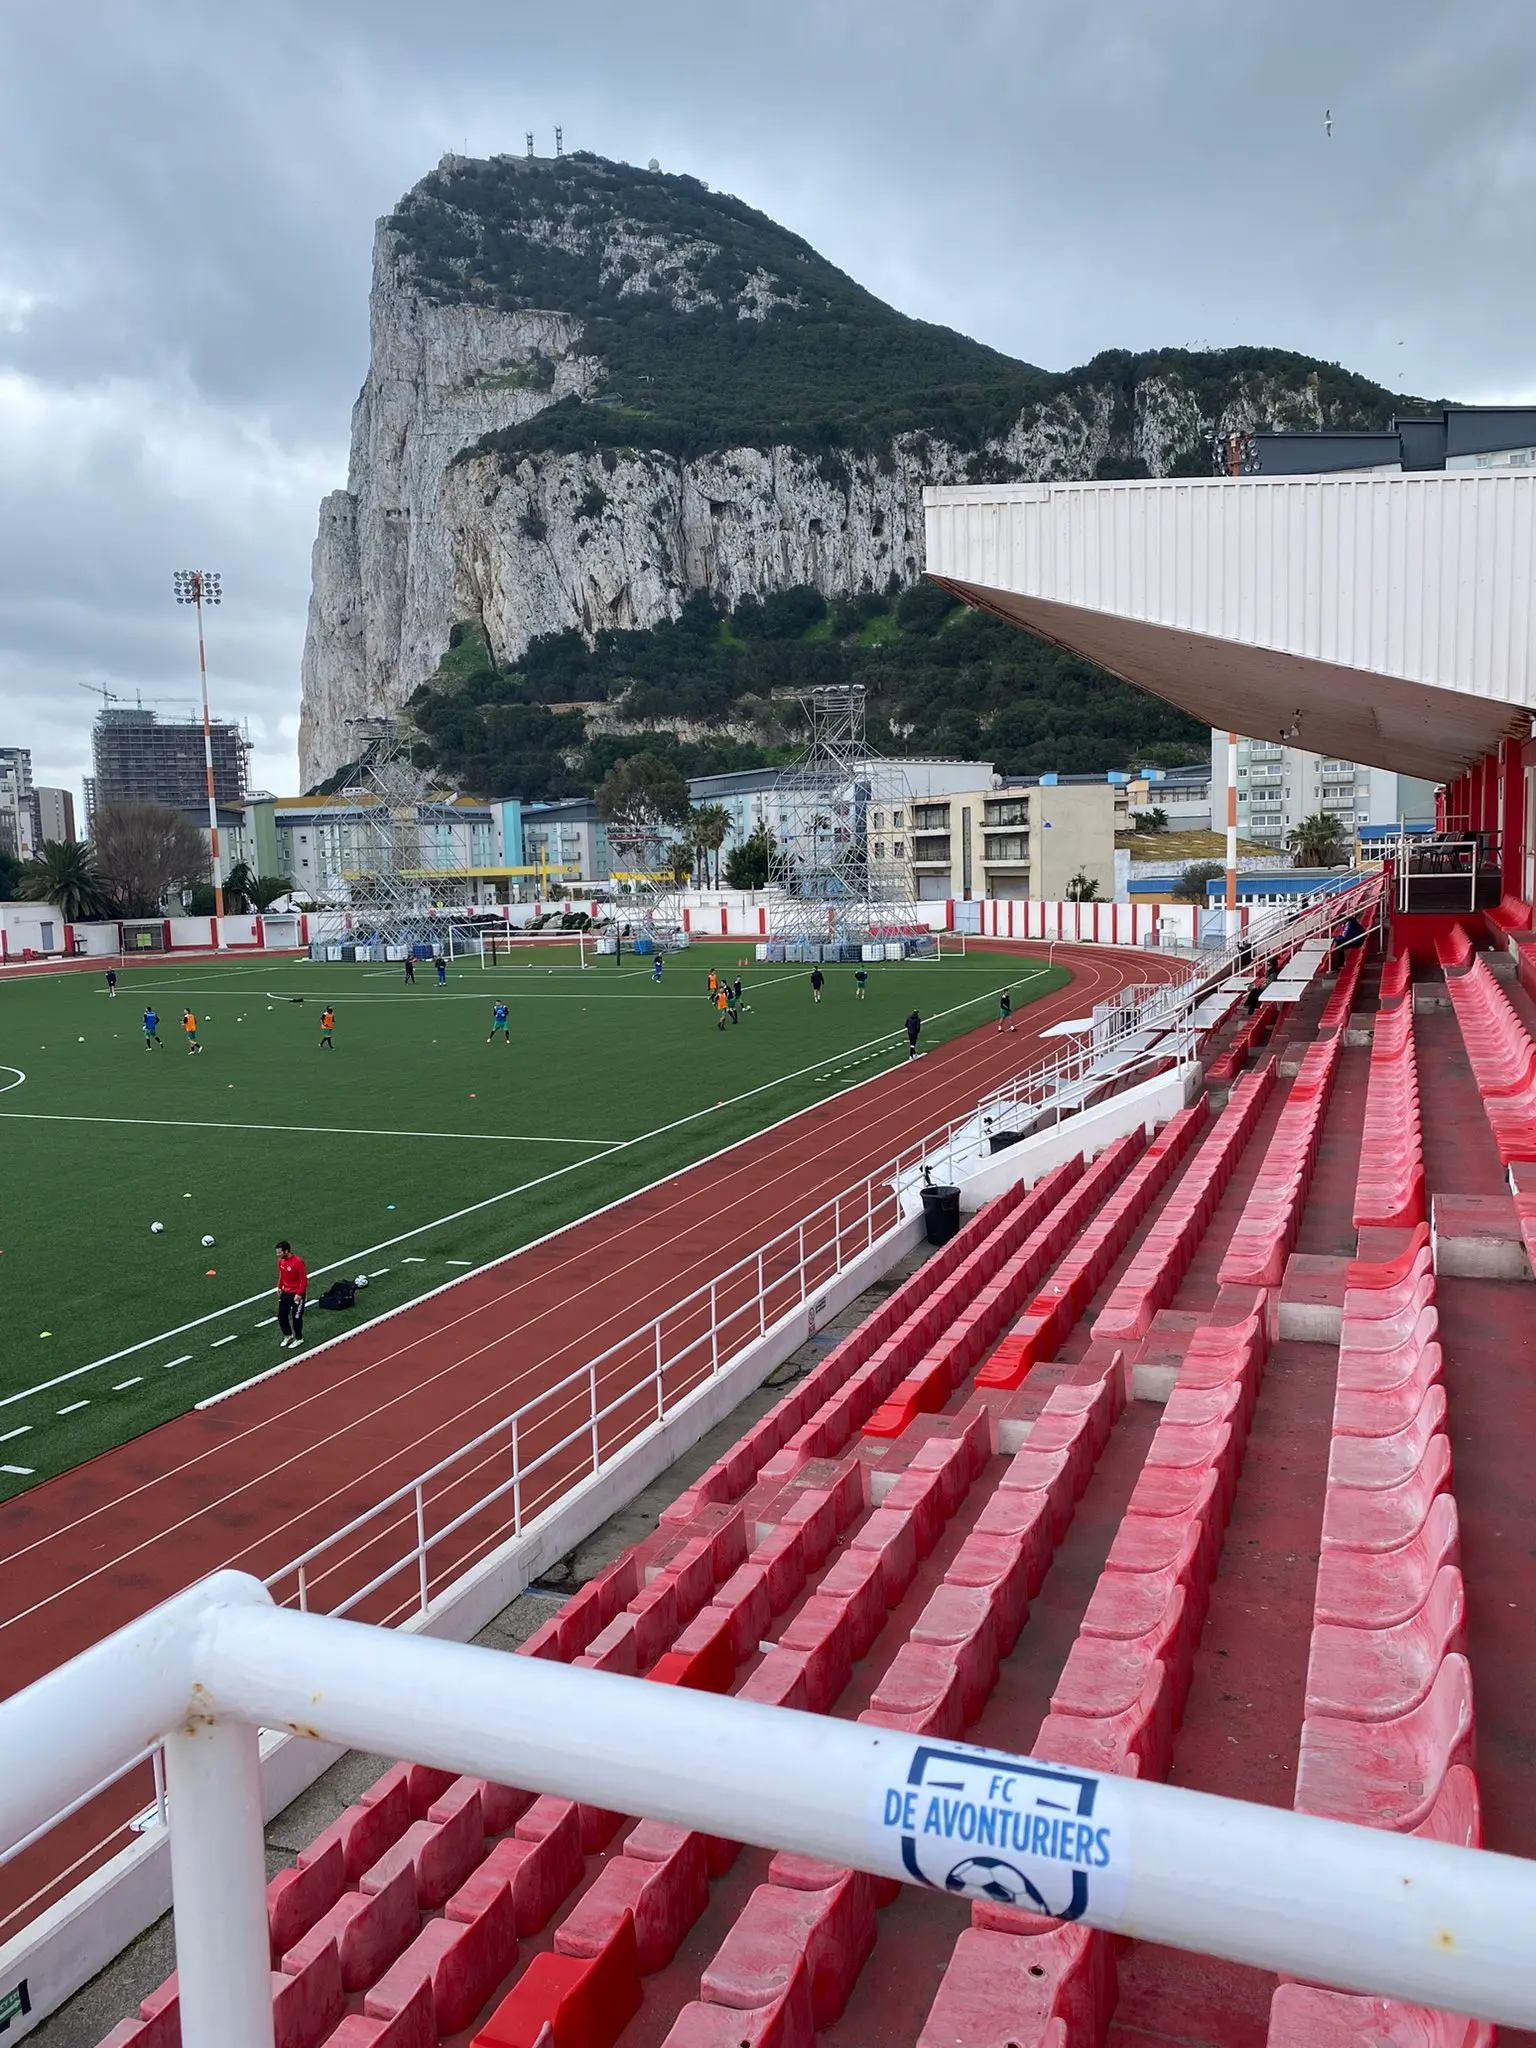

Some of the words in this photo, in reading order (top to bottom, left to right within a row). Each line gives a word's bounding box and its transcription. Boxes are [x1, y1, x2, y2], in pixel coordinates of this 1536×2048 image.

[988, 1775, 1016, 1803] FC
[884, 1788, 919, 1830] DE
[923, 1796, 1111, 1868] AVONTURIERS
